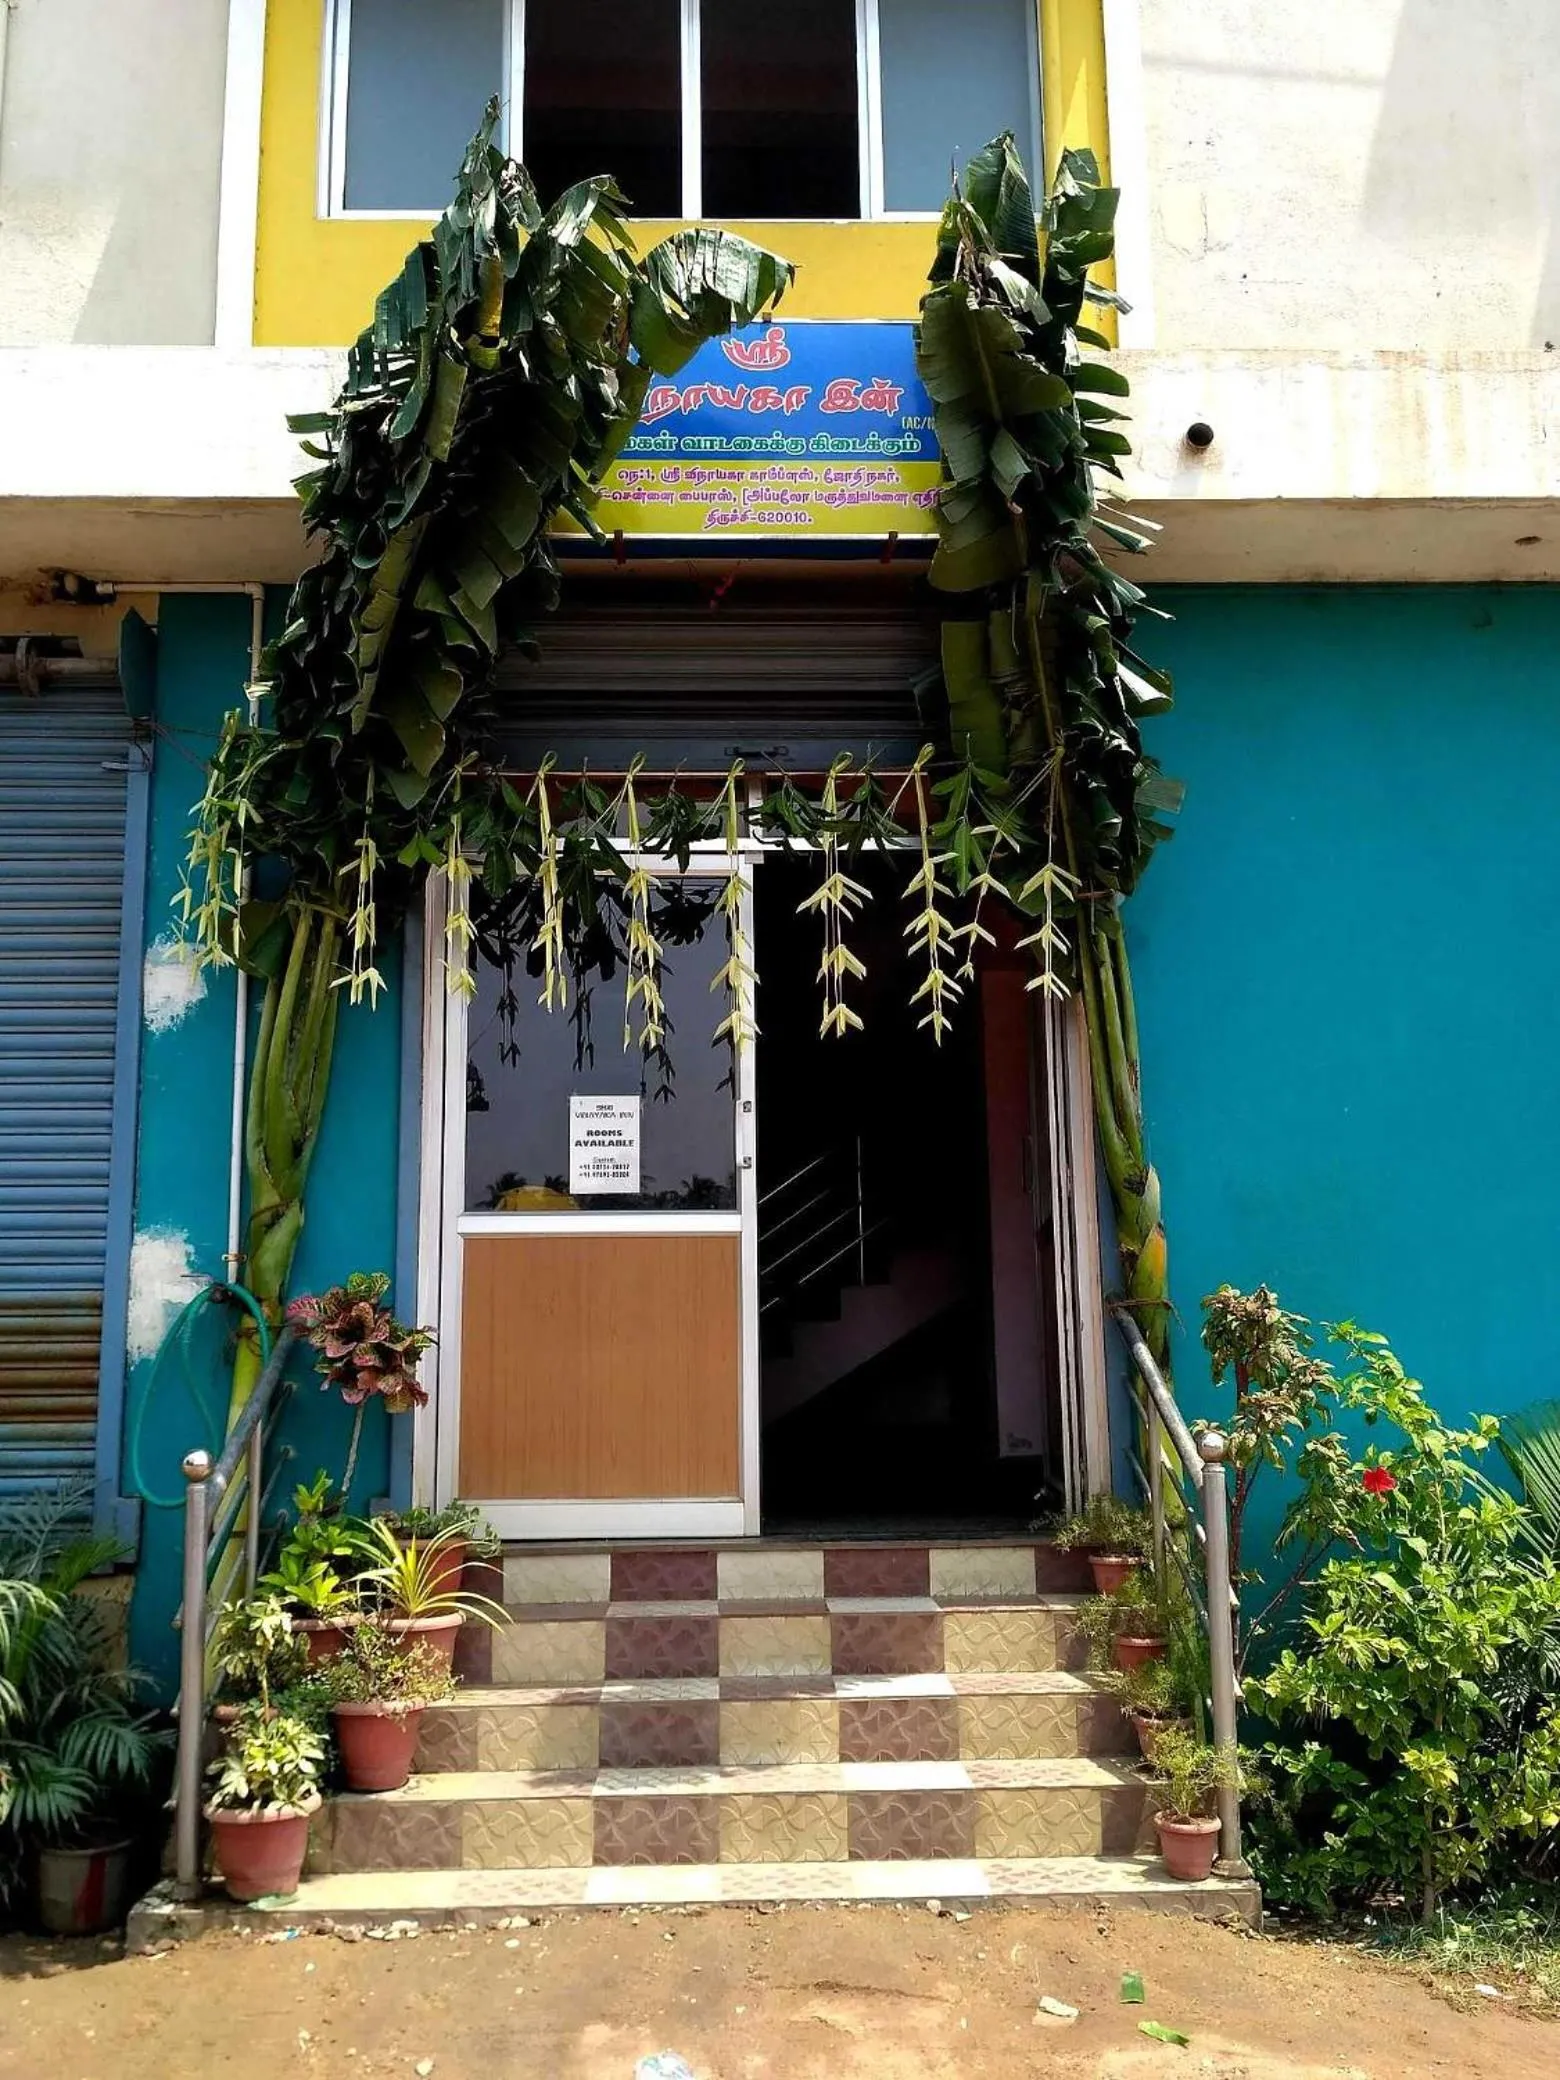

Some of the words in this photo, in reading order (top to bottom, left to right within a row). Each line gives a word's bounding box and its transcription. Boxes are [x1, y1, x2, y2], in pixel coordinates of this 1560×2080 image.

[639, 381, 812, 424] நாயகா
[819, 377, 905, 417] இன்
[681, 430, 806, 455] வாடகைக்கு
[809, 431, 922, 455] கிடைக்கும்
[684, 467, 745, 486] விநாயகா
[814, 487, 908, 508] மருத்துவமனை
